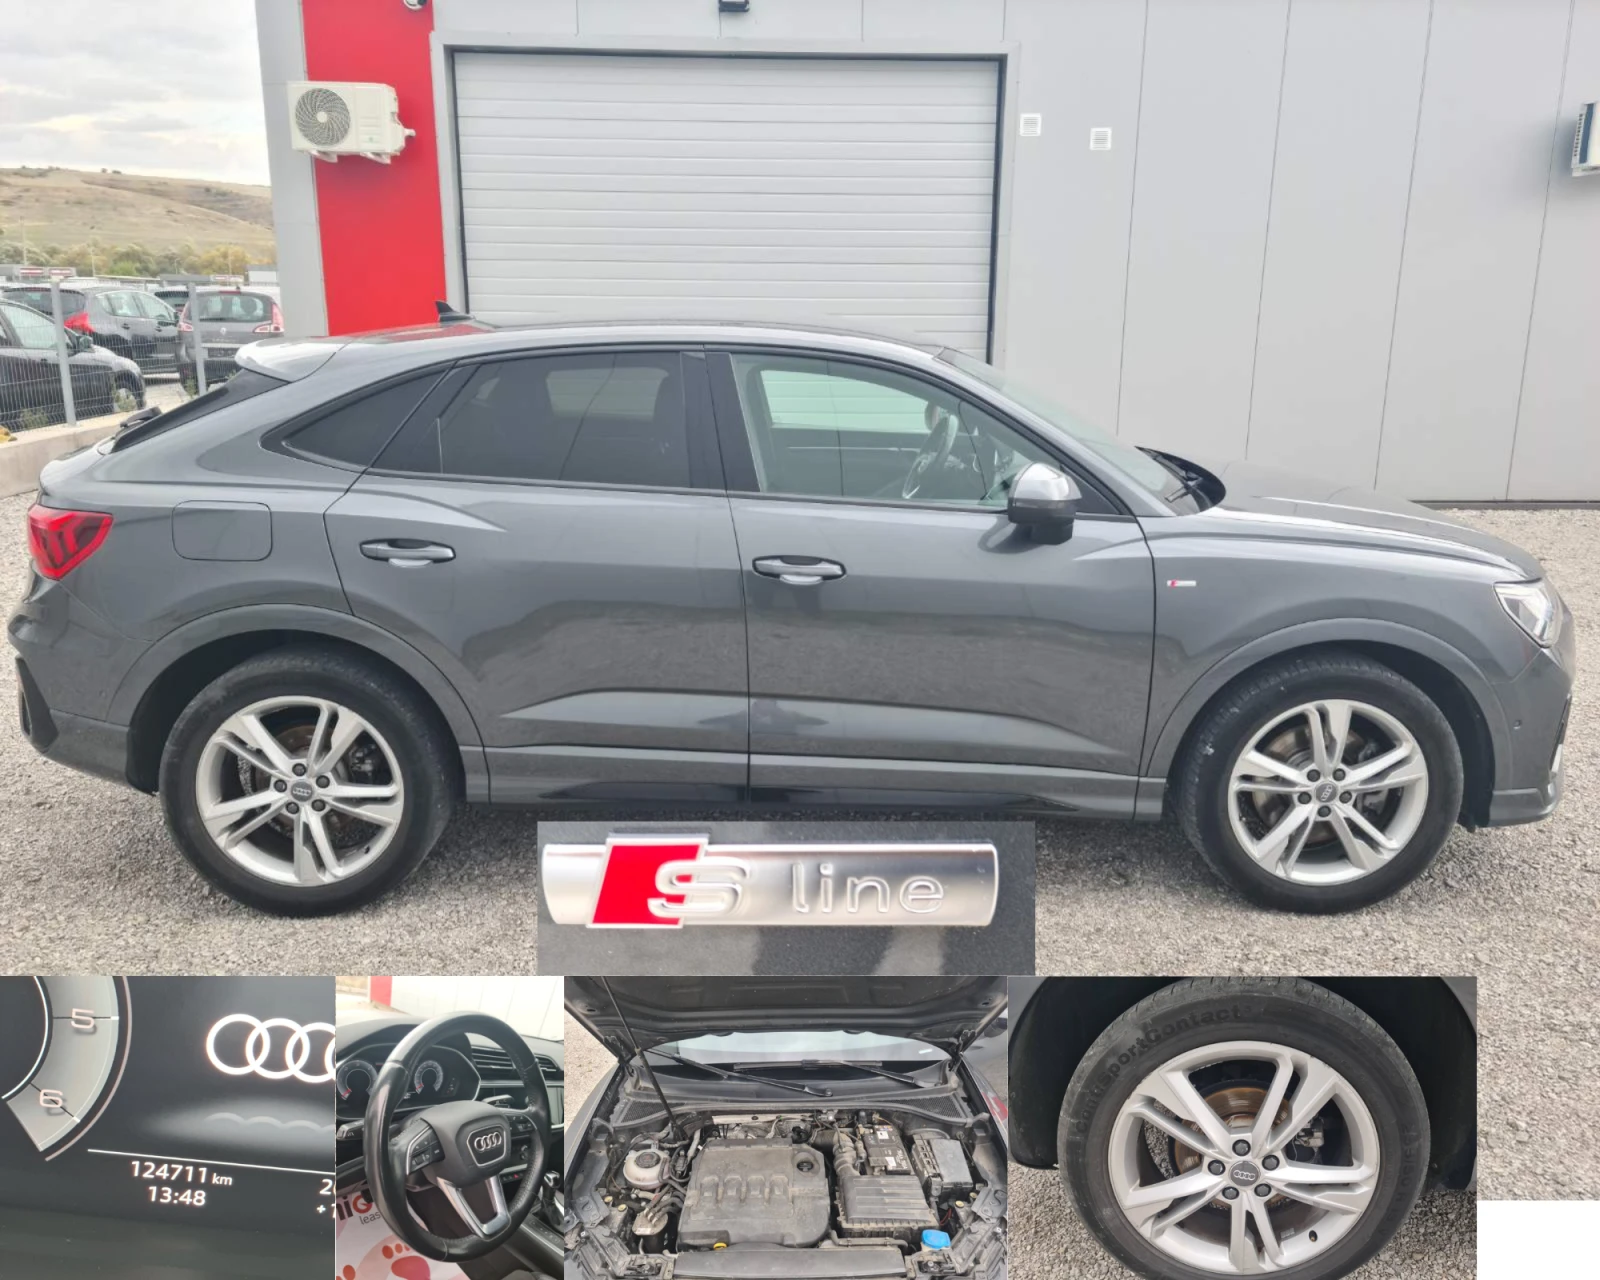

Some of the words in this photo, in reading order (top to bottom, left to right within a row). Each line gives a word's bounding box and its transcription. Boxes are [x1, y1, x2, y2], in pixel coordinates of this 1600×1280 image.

[647, 856, 750, 919] S
[791, 862, 945, 915] line
[70, 1008, 95, 1030] 5
[1075, 1004, 1241, 1134] ContiSportContact
[39, 1088, 64, 1108] 6
[131, 1160, 207, 1184] 124711
[211, 1172, 233, 1186] km
[148, 1185, 206, 1206] 13:48
[319, 1178, 336, 1195] 2
